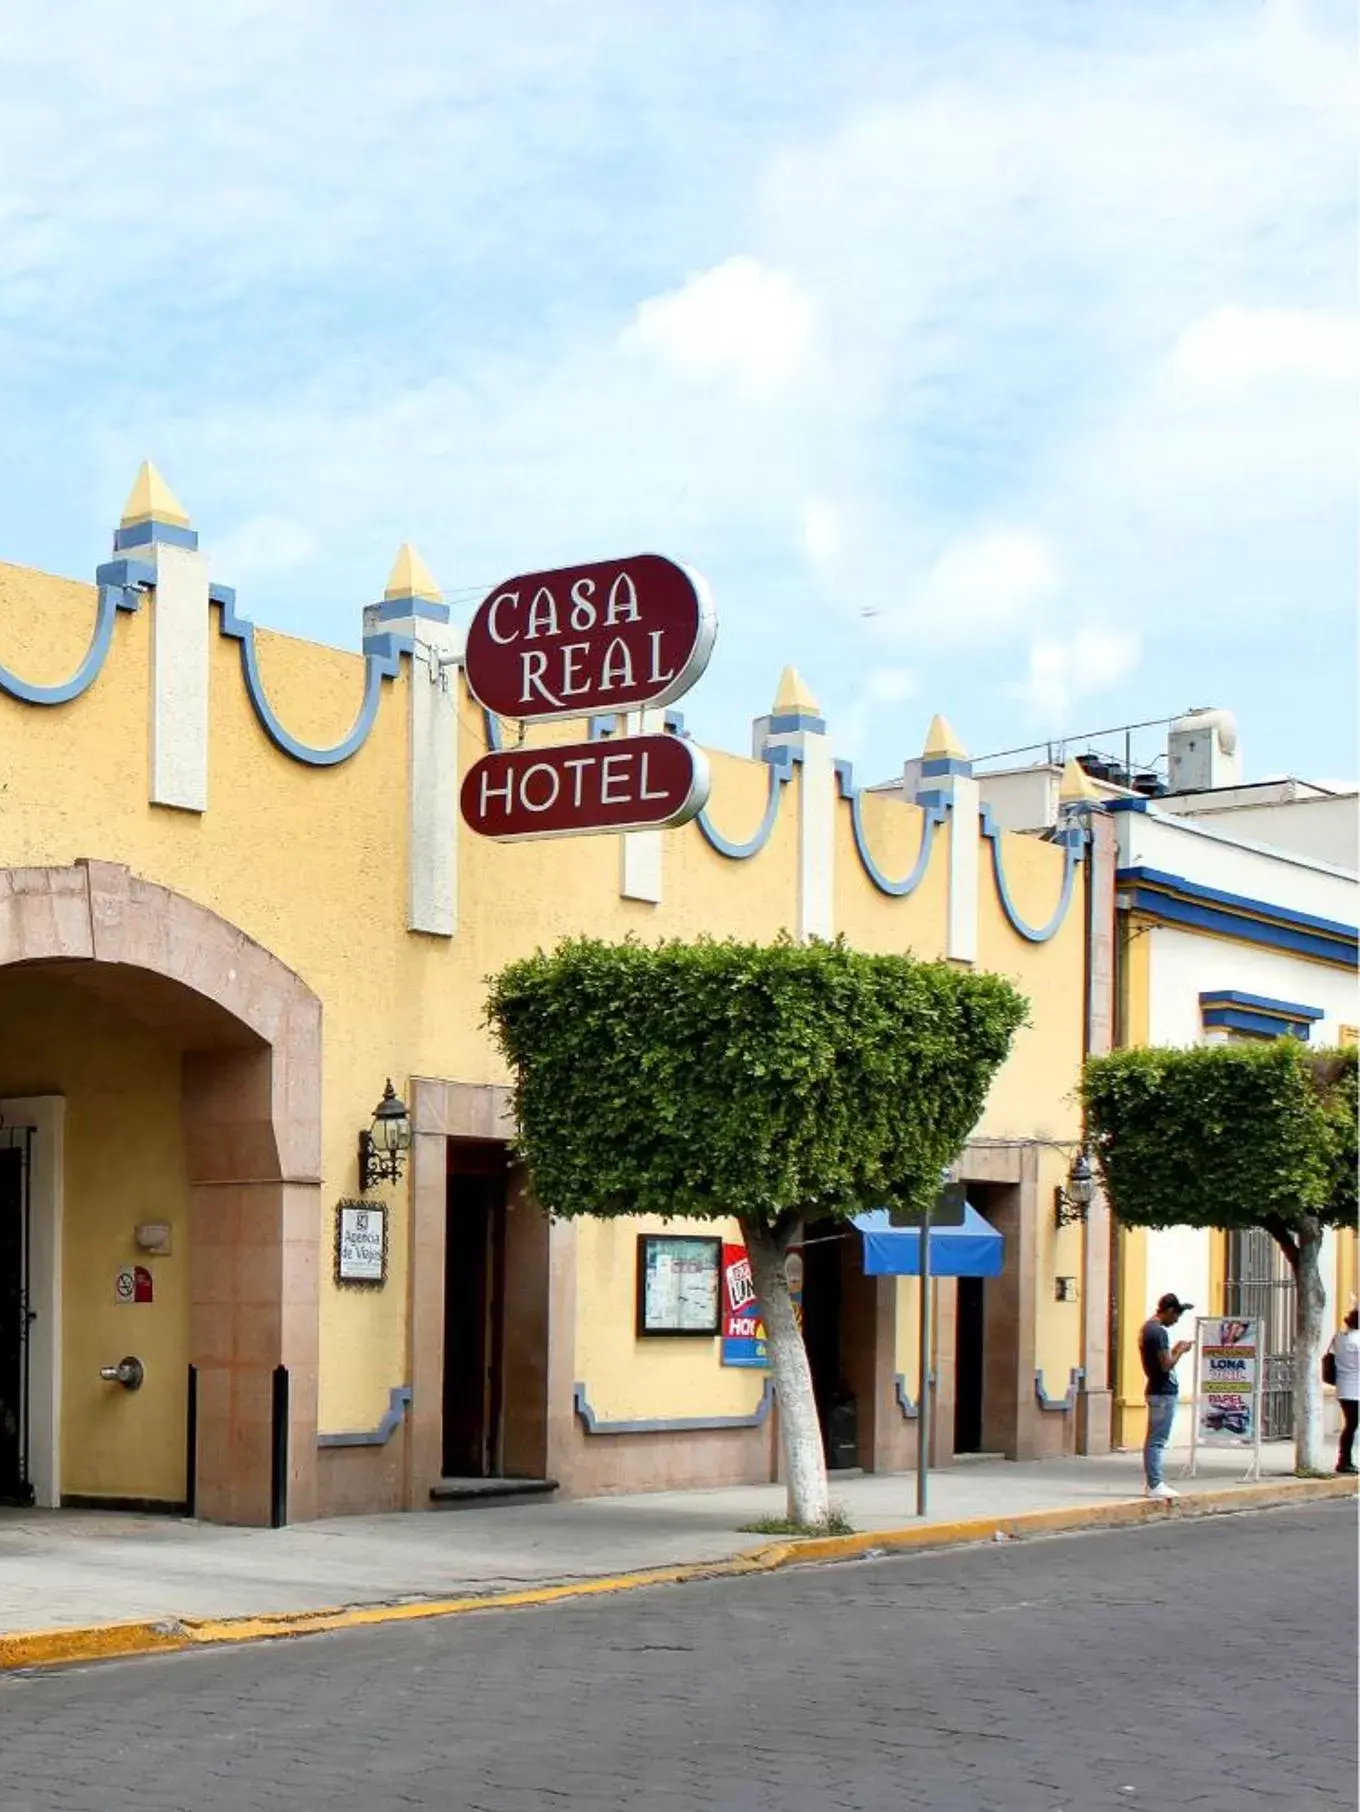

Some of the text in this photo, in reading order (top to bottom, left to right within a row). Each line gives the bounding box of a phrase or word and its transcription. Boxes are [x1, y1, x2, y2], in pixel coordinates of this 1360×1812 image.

[487, 572, 642, 645] CASA
[518, 630, 675, 706] REAL
[480, 752, 670, 817] HOTEL
[344, 1230, 380, 1246] Agencia
[1210, 1359, 1246, 1369] LONA
